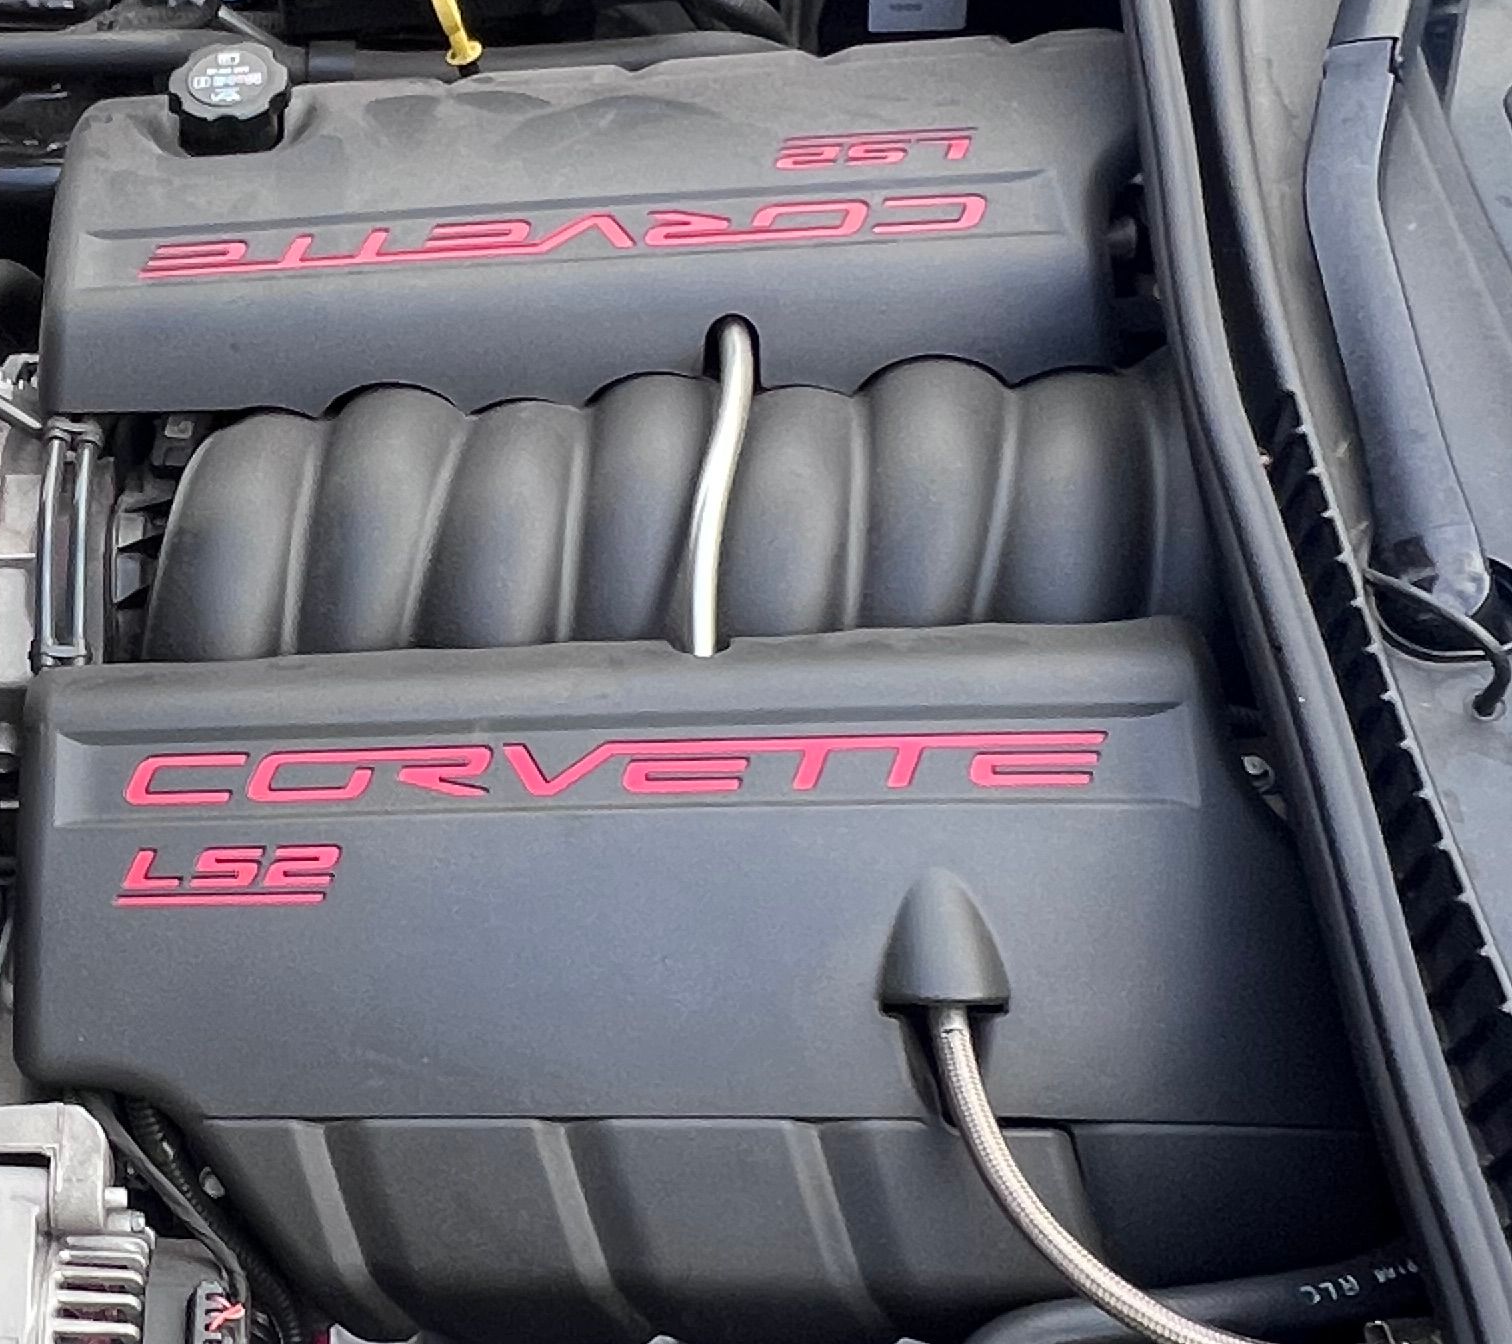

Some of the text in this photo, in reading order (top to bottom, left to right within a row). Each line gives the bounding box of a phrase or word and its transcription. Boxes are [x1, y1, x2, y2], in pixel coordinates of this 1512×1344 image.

[777, 131, 975, 170] LS2
[139, 193, 987, 279] CORVETTE
[123, 731, 1106, 806] CORVETTE
[121, 844, 342, 894] LS2
